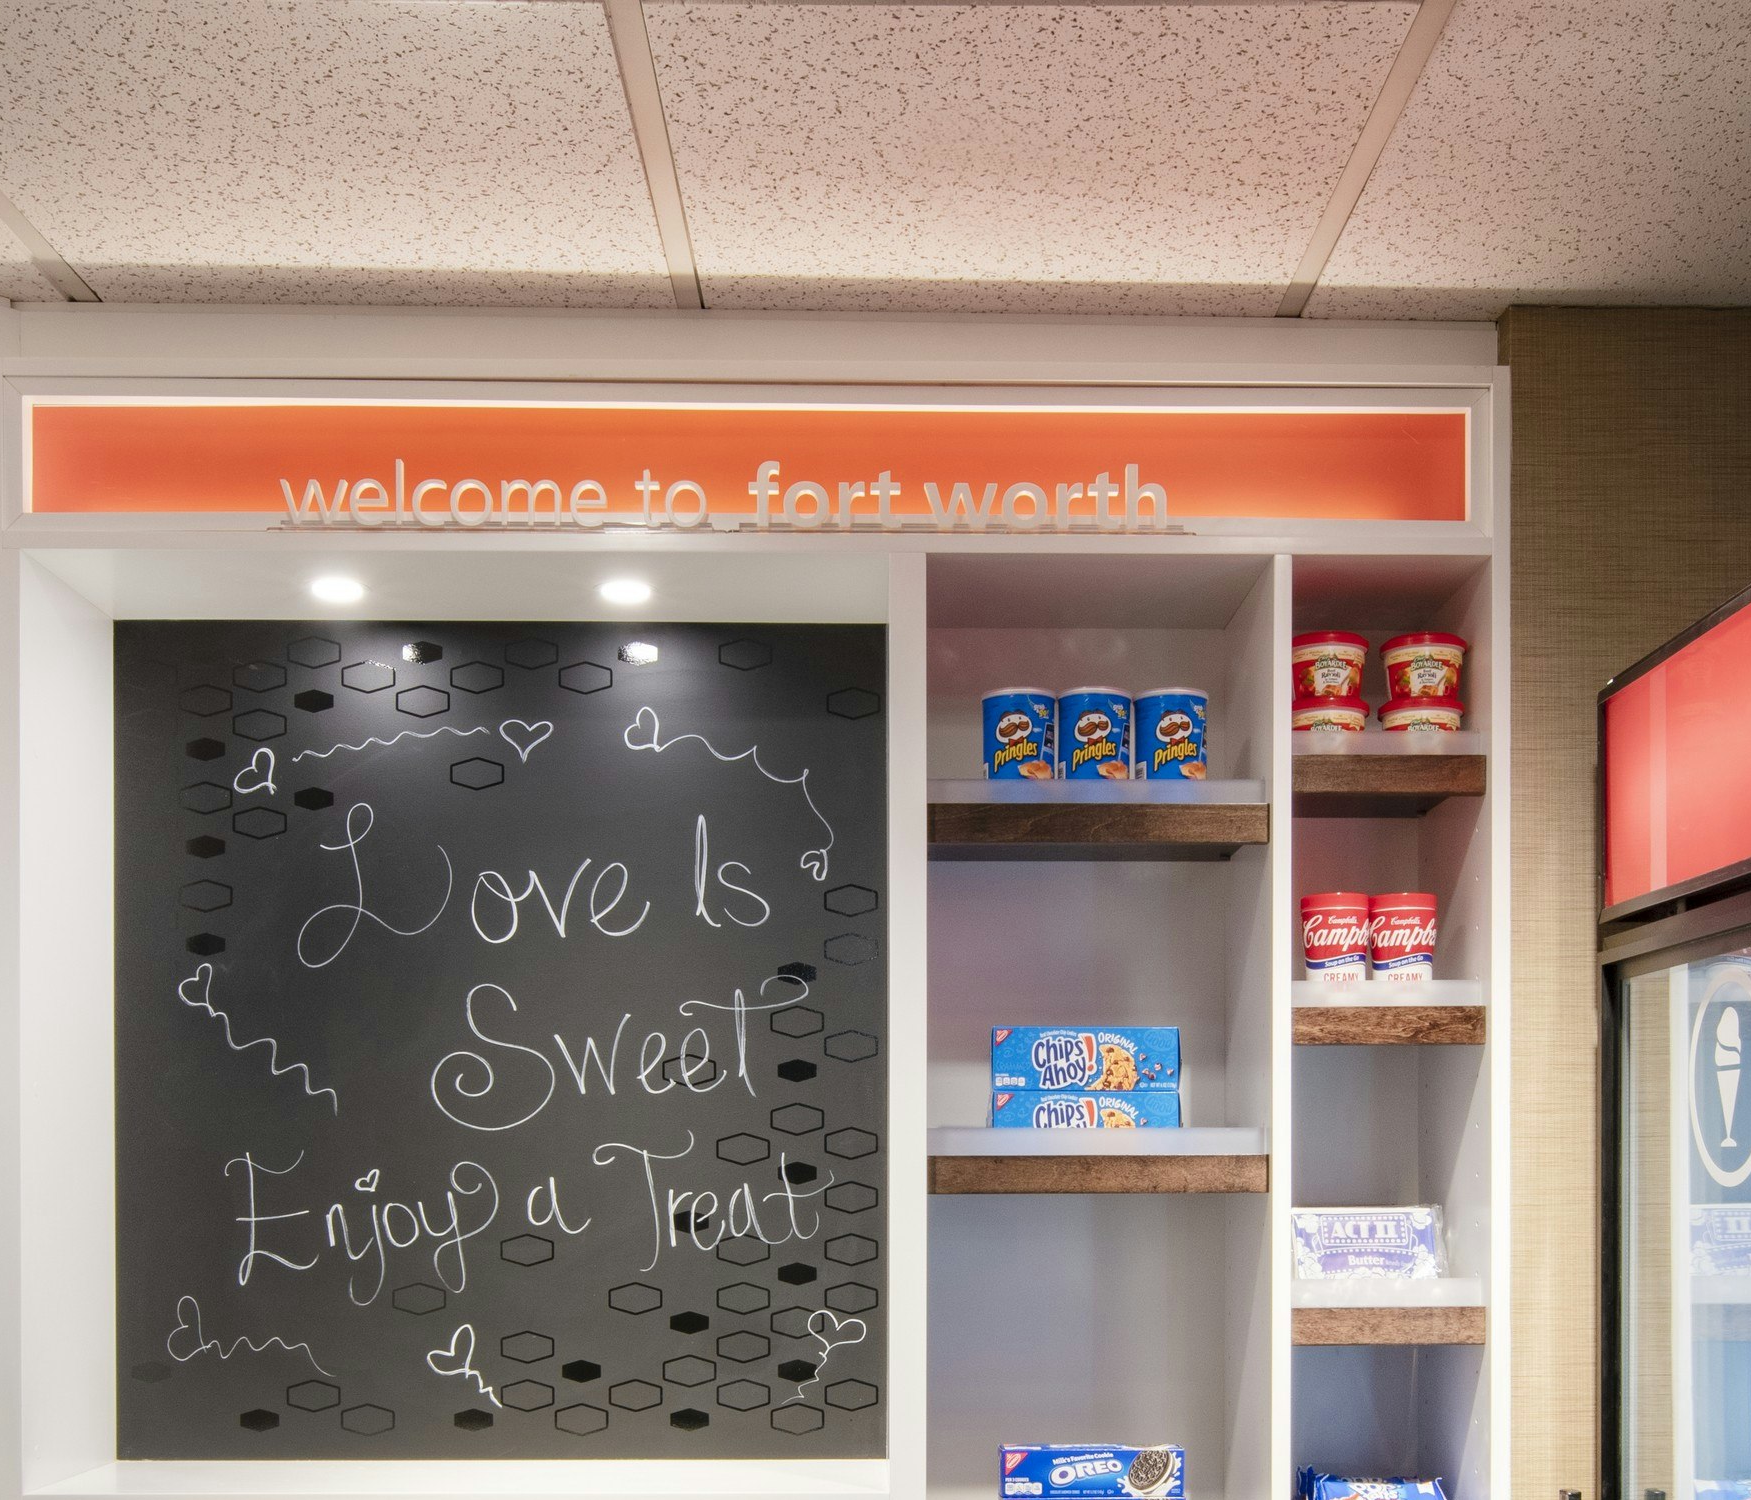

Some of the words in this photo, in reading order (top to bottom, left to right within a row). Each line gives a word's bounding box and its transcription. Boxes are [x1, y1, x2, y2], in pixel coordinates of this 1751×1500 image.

[280, 459, 608, 529] welcome
[635, 468, 708, 529] to
[748, 460, 903, 530] fort
[924, 462, 1167, 531] worth
[1315, 660, 1347, 669] BOYARDEE
[1411, 661, 1443, 671] BOYARDEE
[994, 739, 1037, 772] Pringles
[1072, 739, 1116, 771] Pringles
[1154, 739, 1197, 772] Pringles
[297, 803, 650, 968] Love
[695, 814, 770, 927] Is
[430, 974, 810, 1130] Sweet
[1034, 1037, 1083, 1069] Chips
[1098, 1032, 1138, 1054] ORIGINAL
[1036, 1102, 1084, 1128] Chips
[1099, 1097, 1138, 1119] ORIGINAL
[224, 1150, 500, 1306] Enjoy
[526, 1176, 591, 1235] a
[593, 1130, 834, 1272] Treat
[1331, 1222, 1372, 1238] ACT
[1375, 1222, 1398, 1238] II
[1348, 1256, 1385, 1266] Butter
[1051, 1460, 1123, 1486] OREO
